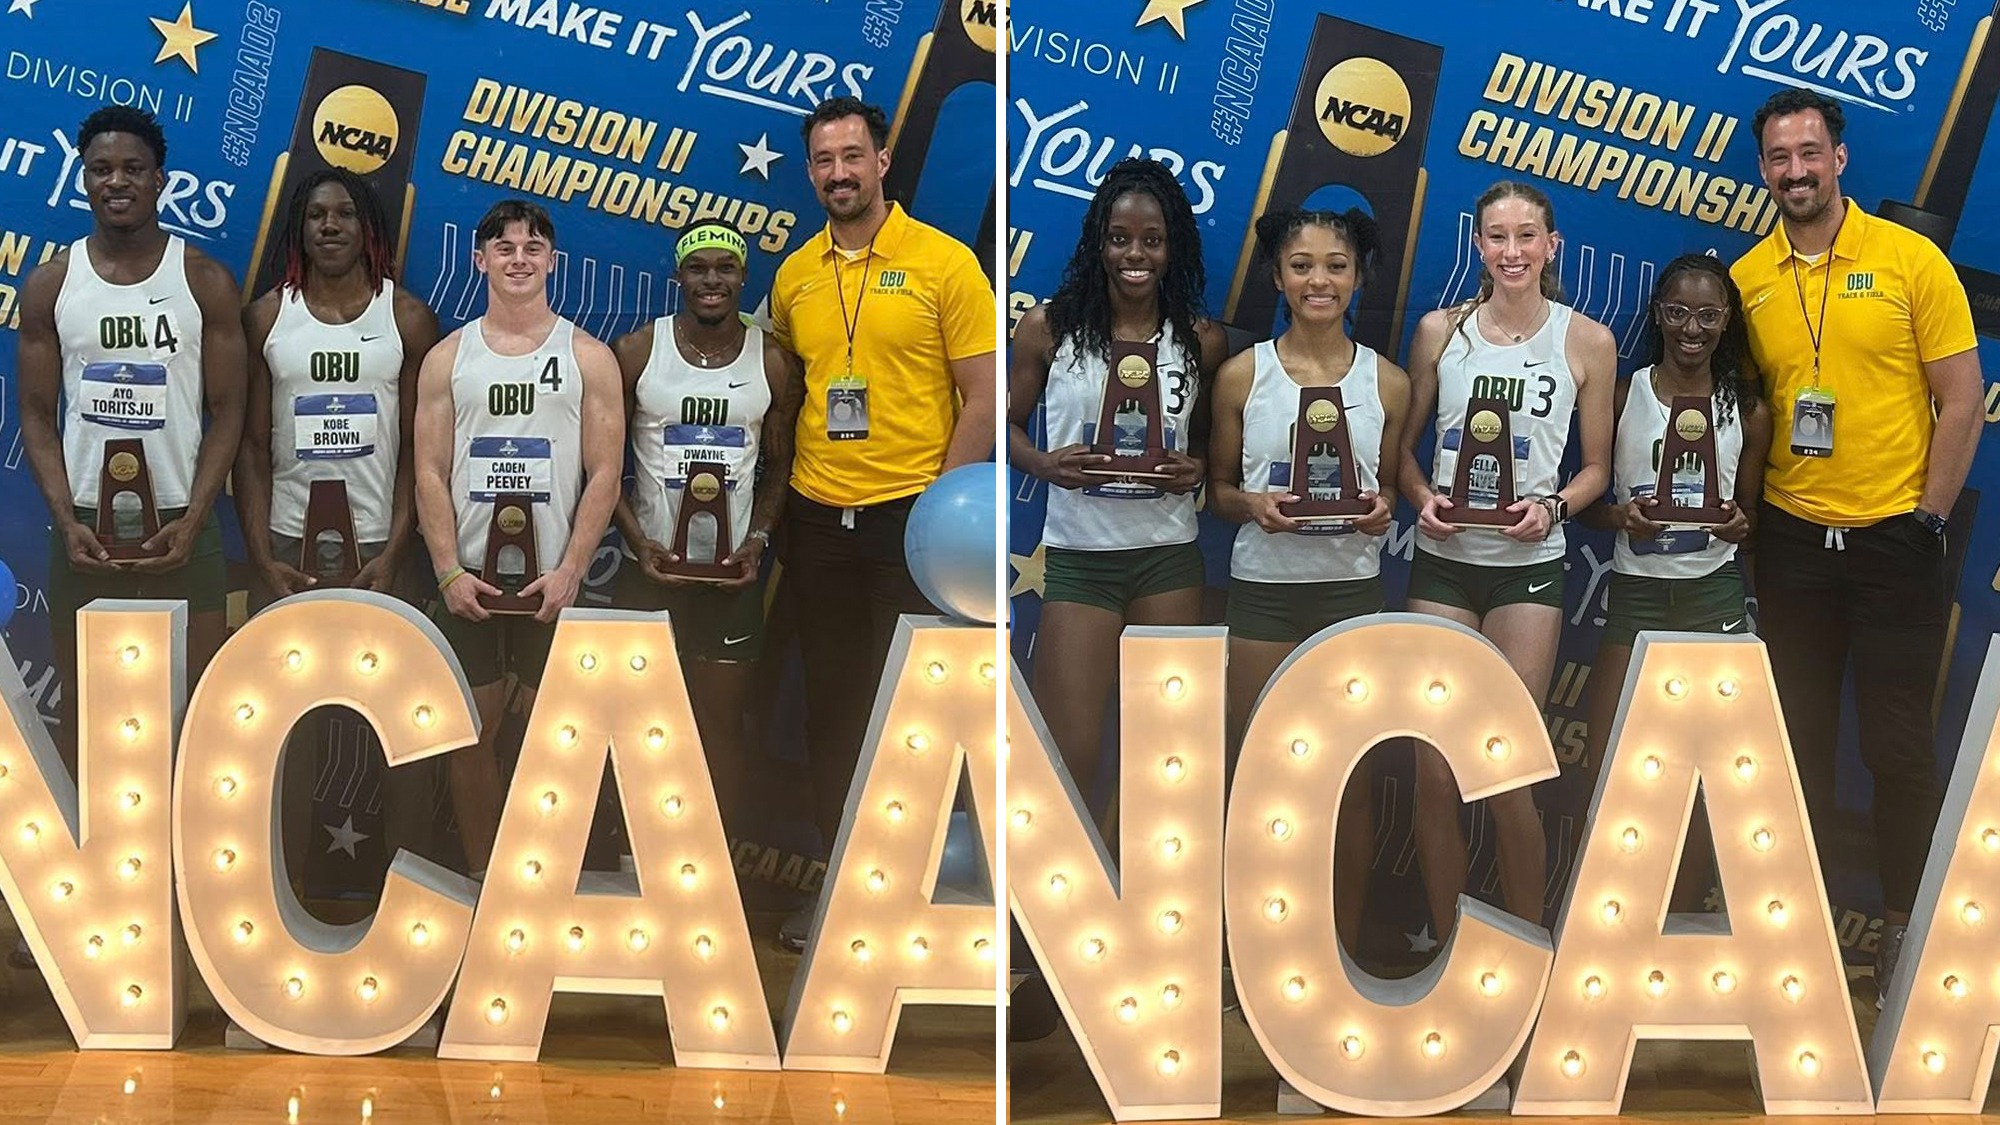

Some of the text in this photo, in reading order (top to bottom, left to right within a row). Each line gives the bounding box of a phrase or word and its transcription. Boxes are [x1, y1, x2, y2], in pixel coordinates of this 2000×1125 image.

[484, 0, 624, 48] MAKE
[626, 20, 677, 61] IT
[676, 10, 874, 108] YOURS
[1663, 0, 1721, 38] IT
[1716, 0, 1929, 101] YOURS
[6, 51, 193, 122] DIVISION II
[221, 0, 281, 167] #NCAAD2
[1158, 62, 1179, 95] II
[1320, 97, 1404, 142] NCAA
[1481, 52, 1738, 163] DIVISION II
[319, 120, 393, 161] NCAA
[462, 77, 697, 174] DIVISION II
[0, 127, 236, 230] IT YRS
[1457, 110, 1781, 237] CHAMPIONSHI
[440, 130, 798, 254] CHAMPIONSHIPS
[879, 270, 906, 287] OBU
[1838, 291, 1858, 299] TRACK
[1846, 273, 1874, 291] OBU
[154, 314, 178, 354] 4
[310, 351, 360, 382] OBU
[539, 356, 562, 392] 4
[92, 399, 153, 416] TORITSJU
[113, 388, 133, 400] AYO
[487, 382, 536, 416] OBU
[1166, 370, 1187, 415] 3
[1530, 375, 1557, 418] 3
[323, 419, 350, 430] KOBE
[681, 396, 729, 426] OBU
[313, 431, 360, 445] BROWN
[684, 449, 726, 461] DWAYNE
[486, 475, 532, 489] PEEVEY
[491, 462, 526, 473] CADEN
[1473, 458, 1498, 473] ELLA
